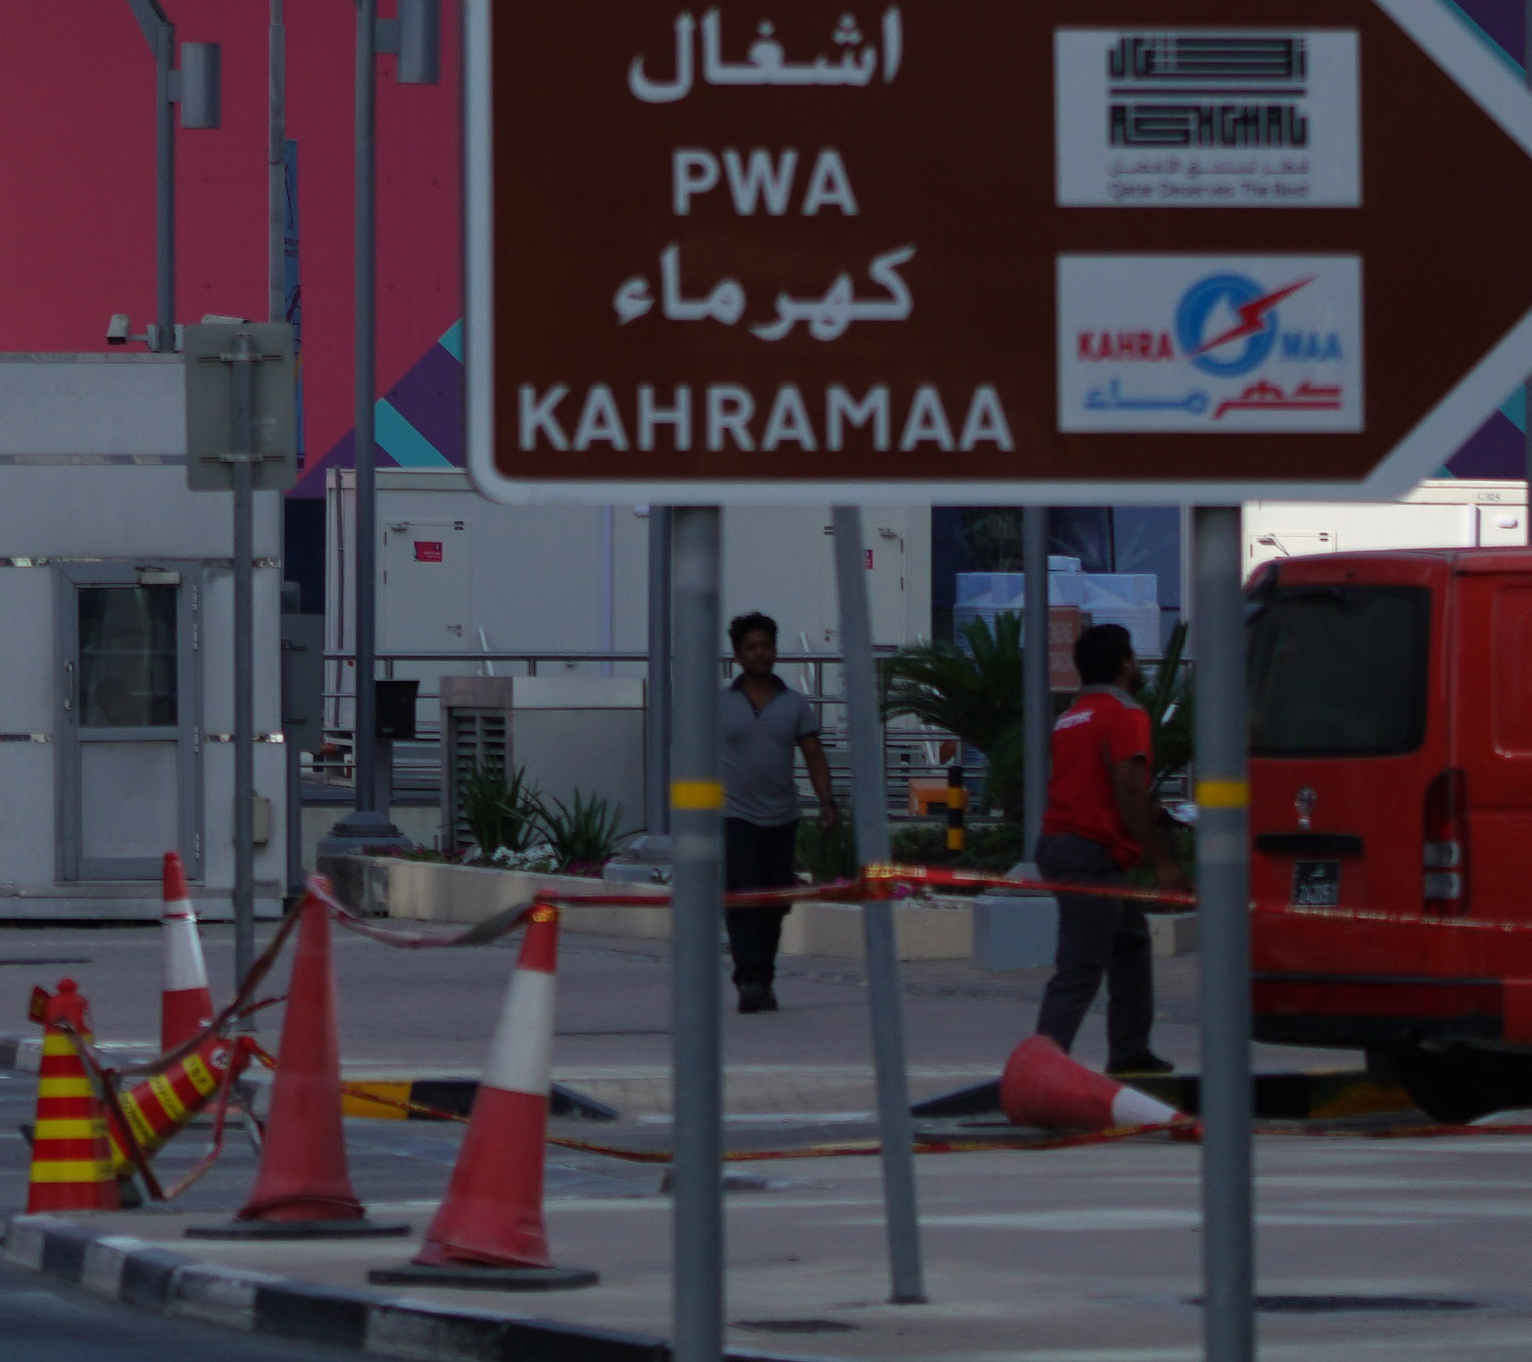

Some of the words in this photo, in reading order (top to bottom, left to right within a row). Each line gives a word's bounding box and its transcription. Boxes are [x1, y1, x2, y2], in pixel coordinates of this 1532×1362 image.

[671, 146, 859, 217] PWA
[613, 240, 918, 342] كهرماء
[517, 382, 1016, 452] KAHRAMAA
